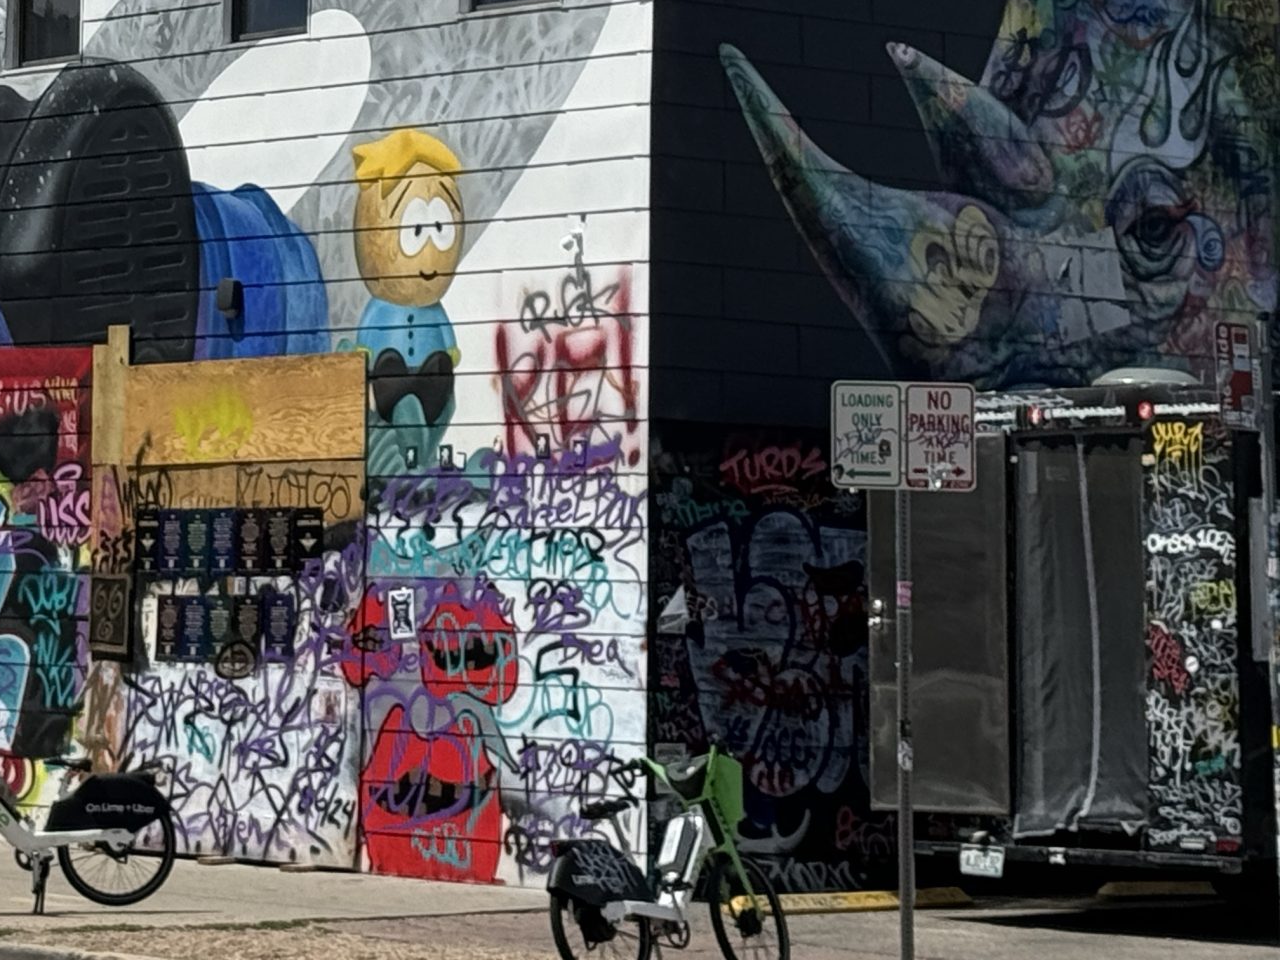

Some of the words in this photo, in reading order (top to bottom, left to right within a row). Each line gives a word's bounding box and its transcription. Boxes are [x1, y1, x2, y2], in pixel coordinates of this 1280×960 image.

[841, 393, 894, 408] LOADING
[927, 390, 952, 409] NO
[852, 413, 883, 427] ONLY
[908, 414, 971, 433] PARKING
[849, 450, 887, 465] TIMES
[924, 450, 956, 466] TIME
[719, 445, 828, 488] TURDS
[85, 803, 101, 813] On
[102, 802, 125, 813] Lime
[132, 803, 155, 814] Uber
